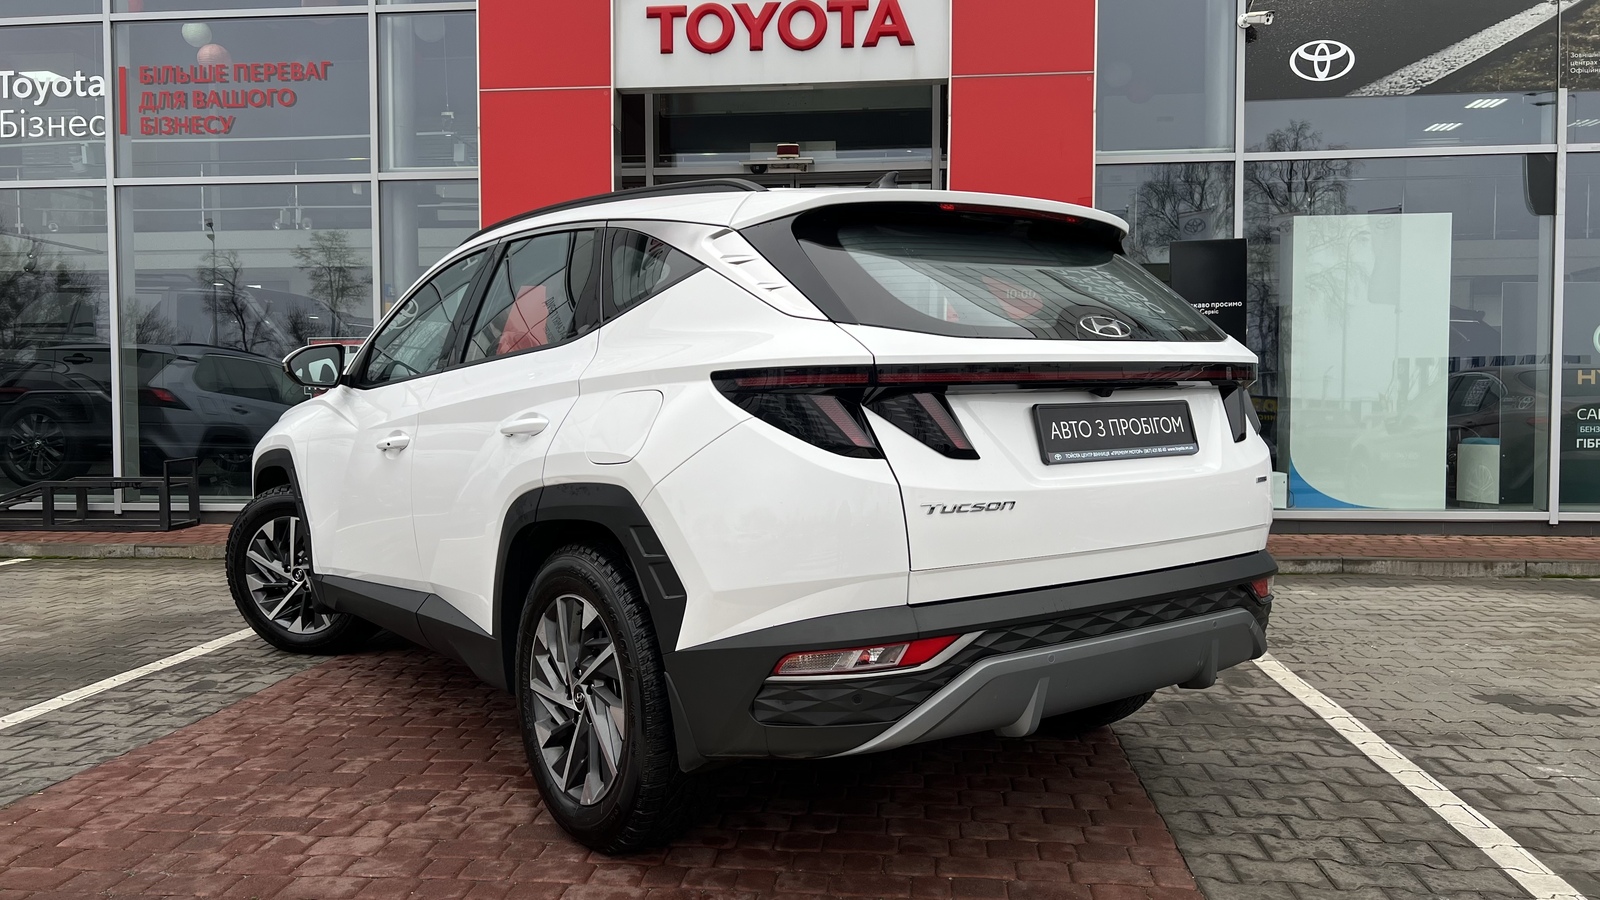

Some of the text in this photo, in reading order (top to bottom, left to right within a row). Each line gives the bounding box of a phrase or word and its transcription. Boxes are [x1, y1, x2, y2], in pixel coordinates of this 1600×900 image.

[646, 0, 915, 54] TOYOTA
[139, 61, 334, 85] БІЛЬШЕ ПЕРЕВАГ
[1570, 66, 1600, 74] Офіційн
[0, 70, 105, 106] Toyota
[138, 88, 297, 114] ДЛЯ ВАШОГО
[0, 109, 106, 138] Бізнес
[140, 115, 235, 136] БІЗНЕСУ
[1211, 301, 1243, 309] просимо
[1577, 369, 1600, 385] H
[1051, 420, 1093, 440] АВТО
[1108, 416, 1185, 437] ПРОБІГОМ
